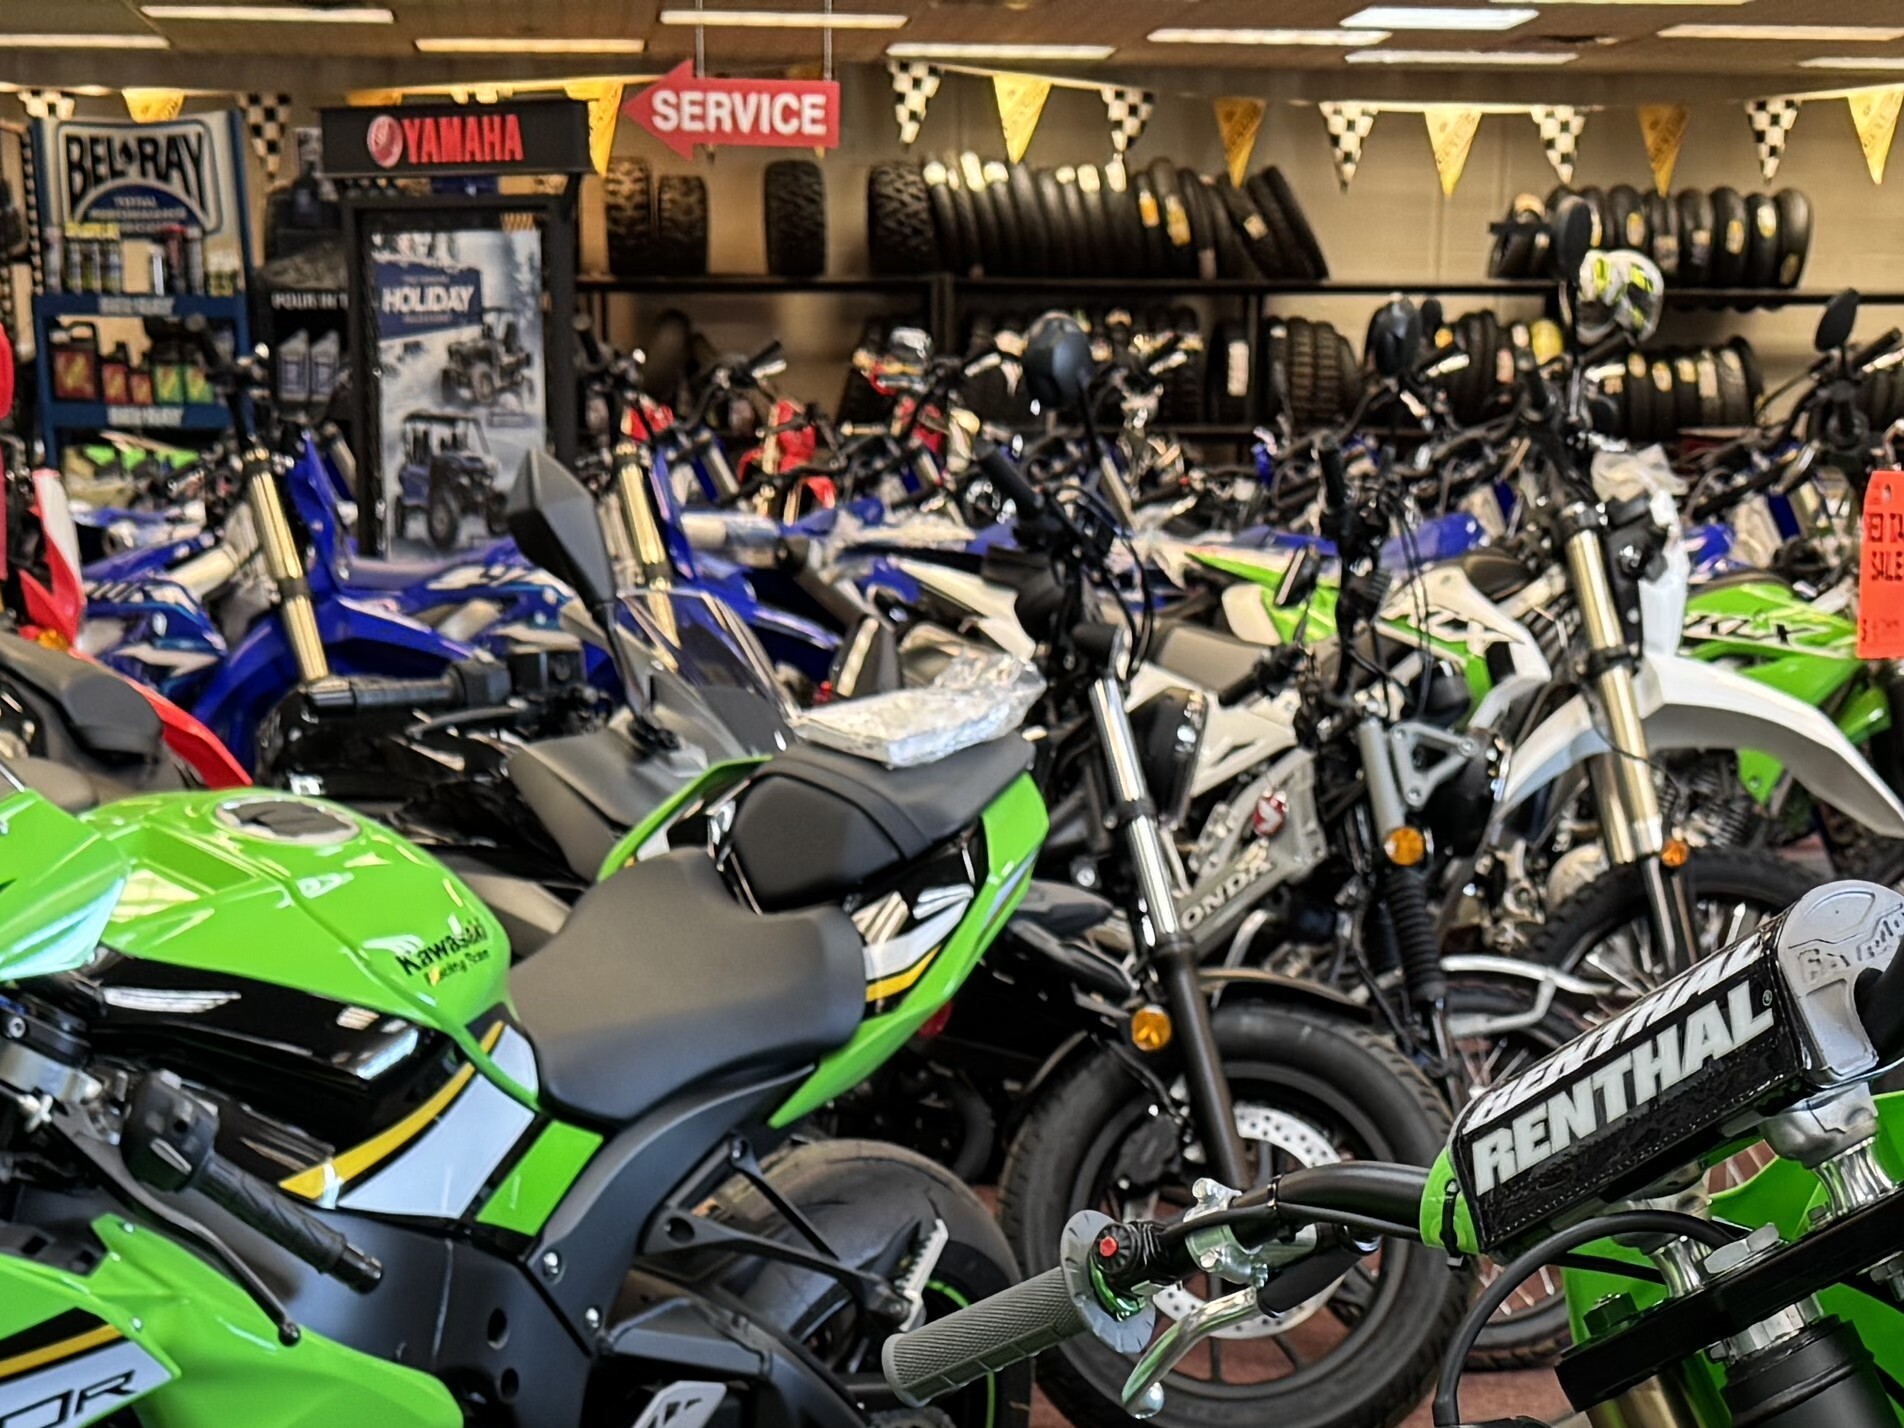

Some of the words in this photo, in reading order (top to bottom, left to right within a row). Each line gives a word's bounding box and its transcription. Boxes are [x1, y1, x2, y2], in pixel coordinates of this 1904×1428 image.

[651, 89, 828, 135] SERVICE
[401, 113, 525, 165] YAMAHA
[381, 285, 475, 314] HOLIDAY
[1871, 551, 1904, 581] SALE
[1181, 856, 1274, 930] ONDA
[1472, 980, 1775, 1196] RENTHAL
